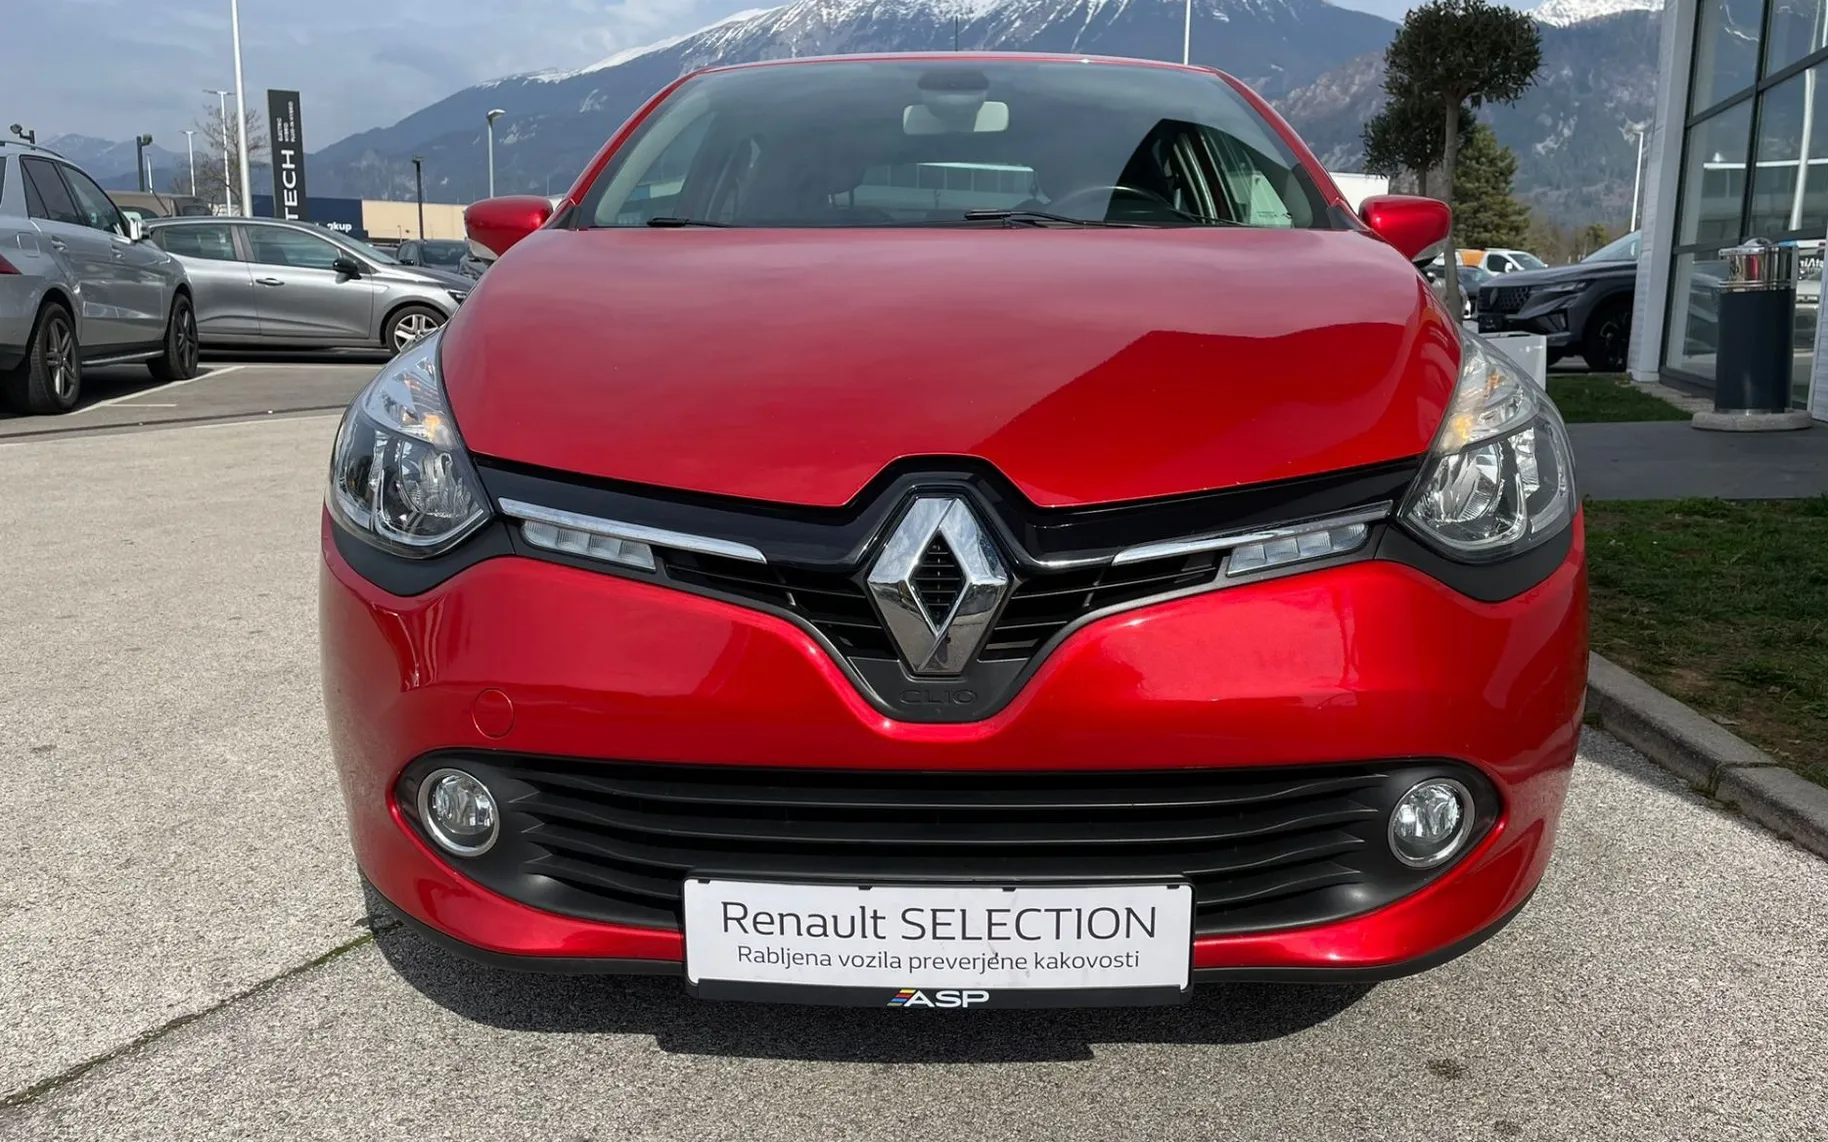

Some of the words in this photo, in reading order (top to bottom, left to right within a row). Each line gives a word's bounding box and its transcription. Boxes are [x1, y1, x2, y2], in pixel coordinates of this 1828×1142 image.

[899, 688, 977, 705] CLIO
[721, 901, 887, 940] Renault
[900, 906, 1156, 941] SELECTION
[738, 945, 832, 969] Rabljena
[838, 951, 902, 969] vozila
[909, 952, 1027, 975] preverjene
[1034, 950, 1140, 970] kakovosti
[903, 990, 990, 1008] ASP
